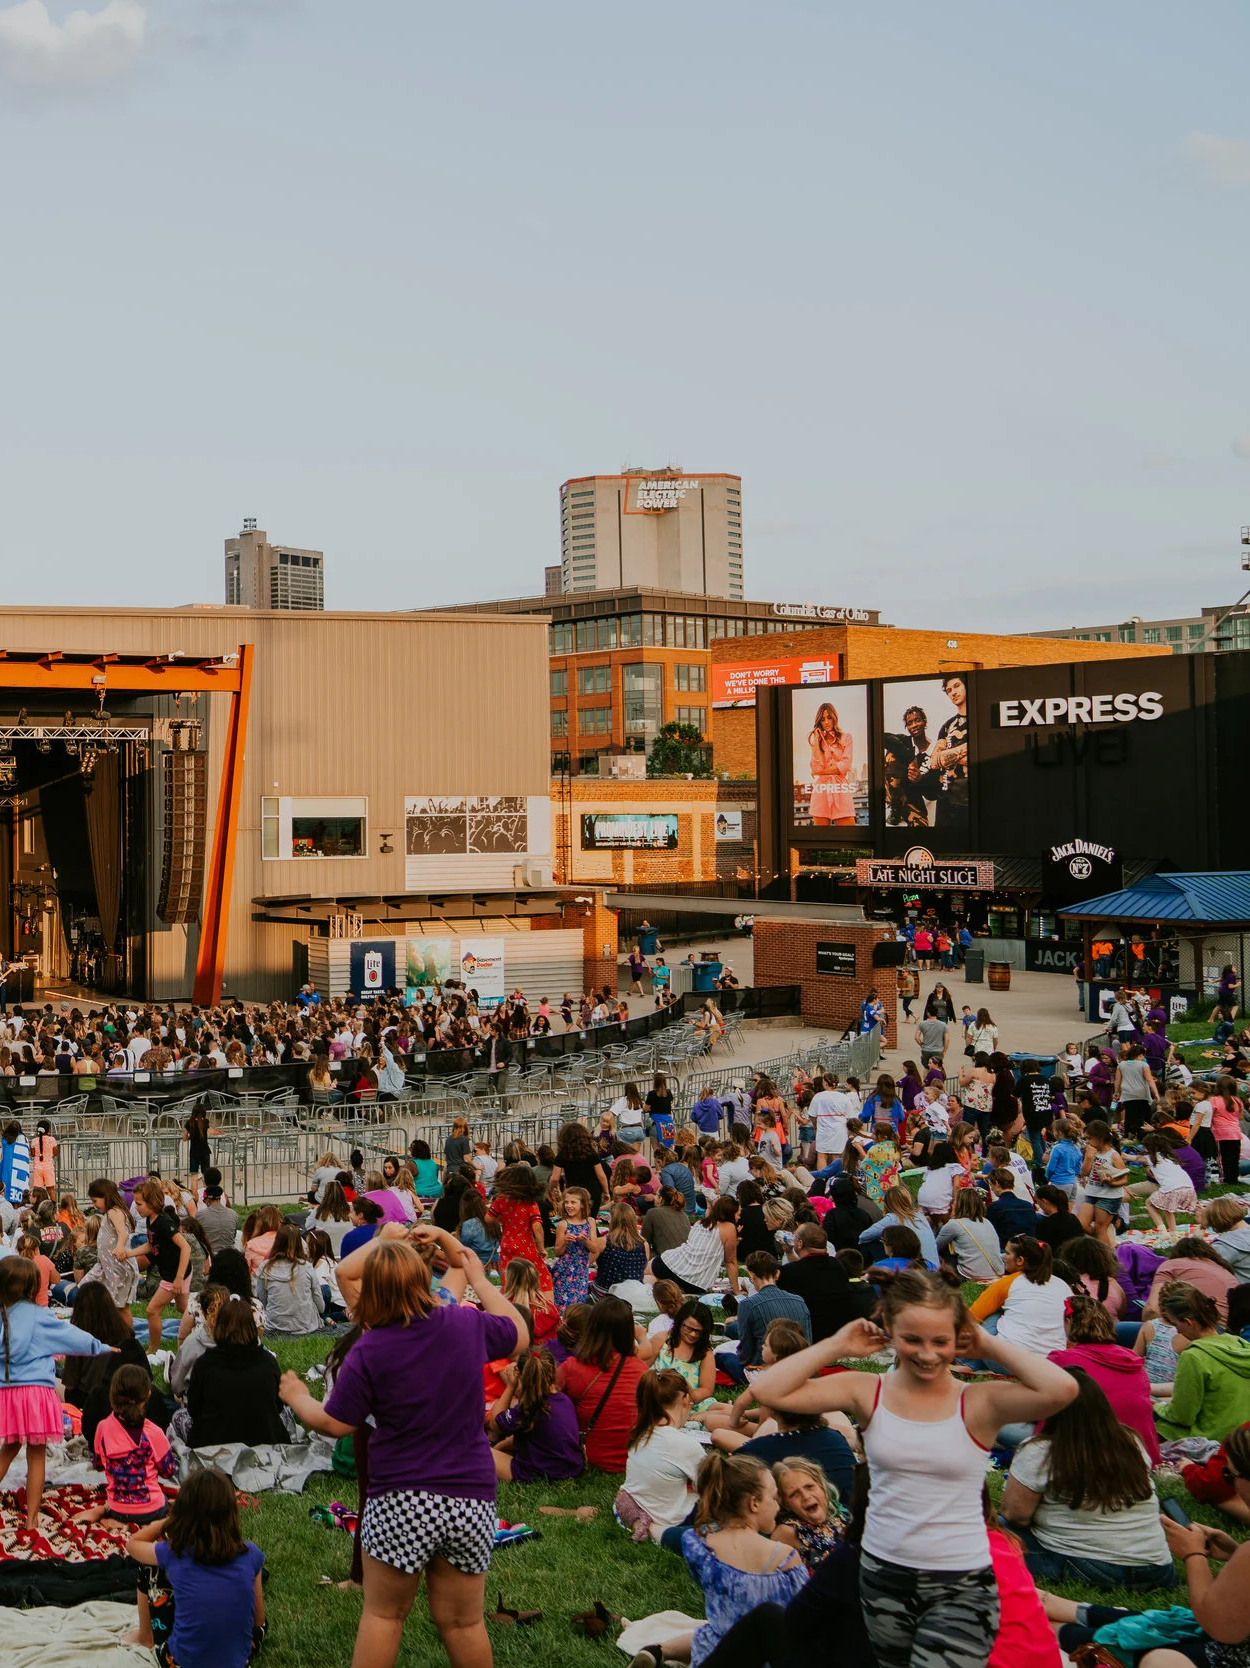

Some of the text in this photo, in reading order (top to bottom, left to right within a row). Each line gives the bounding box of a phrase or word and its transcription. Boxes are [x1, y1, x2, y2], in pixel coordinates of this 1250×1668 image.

[638, 480, 699, 490] AMERICAN
[637, 490, 687, 499] ELECTRIC
[636, 499, 679, 508] POWER
[773, 602, 870, 621] Columbia Gas of Ohio
[730, 669, 780, 679] DON'T WORRY
[724, 676, 786, 688] WE'VE DONE THIS
[726, 686, 756, 695] A MILLIO
[1000, 692, 1164, 727] EXPRESS
[804, 783, 857, 794] EXPRESS
[1051, 838, 1115, 864] JACK DANIEL'S
[870, 869, 976, 885] LATE NIGHT SLICE
[367, 960, 381, 970] Lite
[1172, 1002, 1186, 1010] Lite
